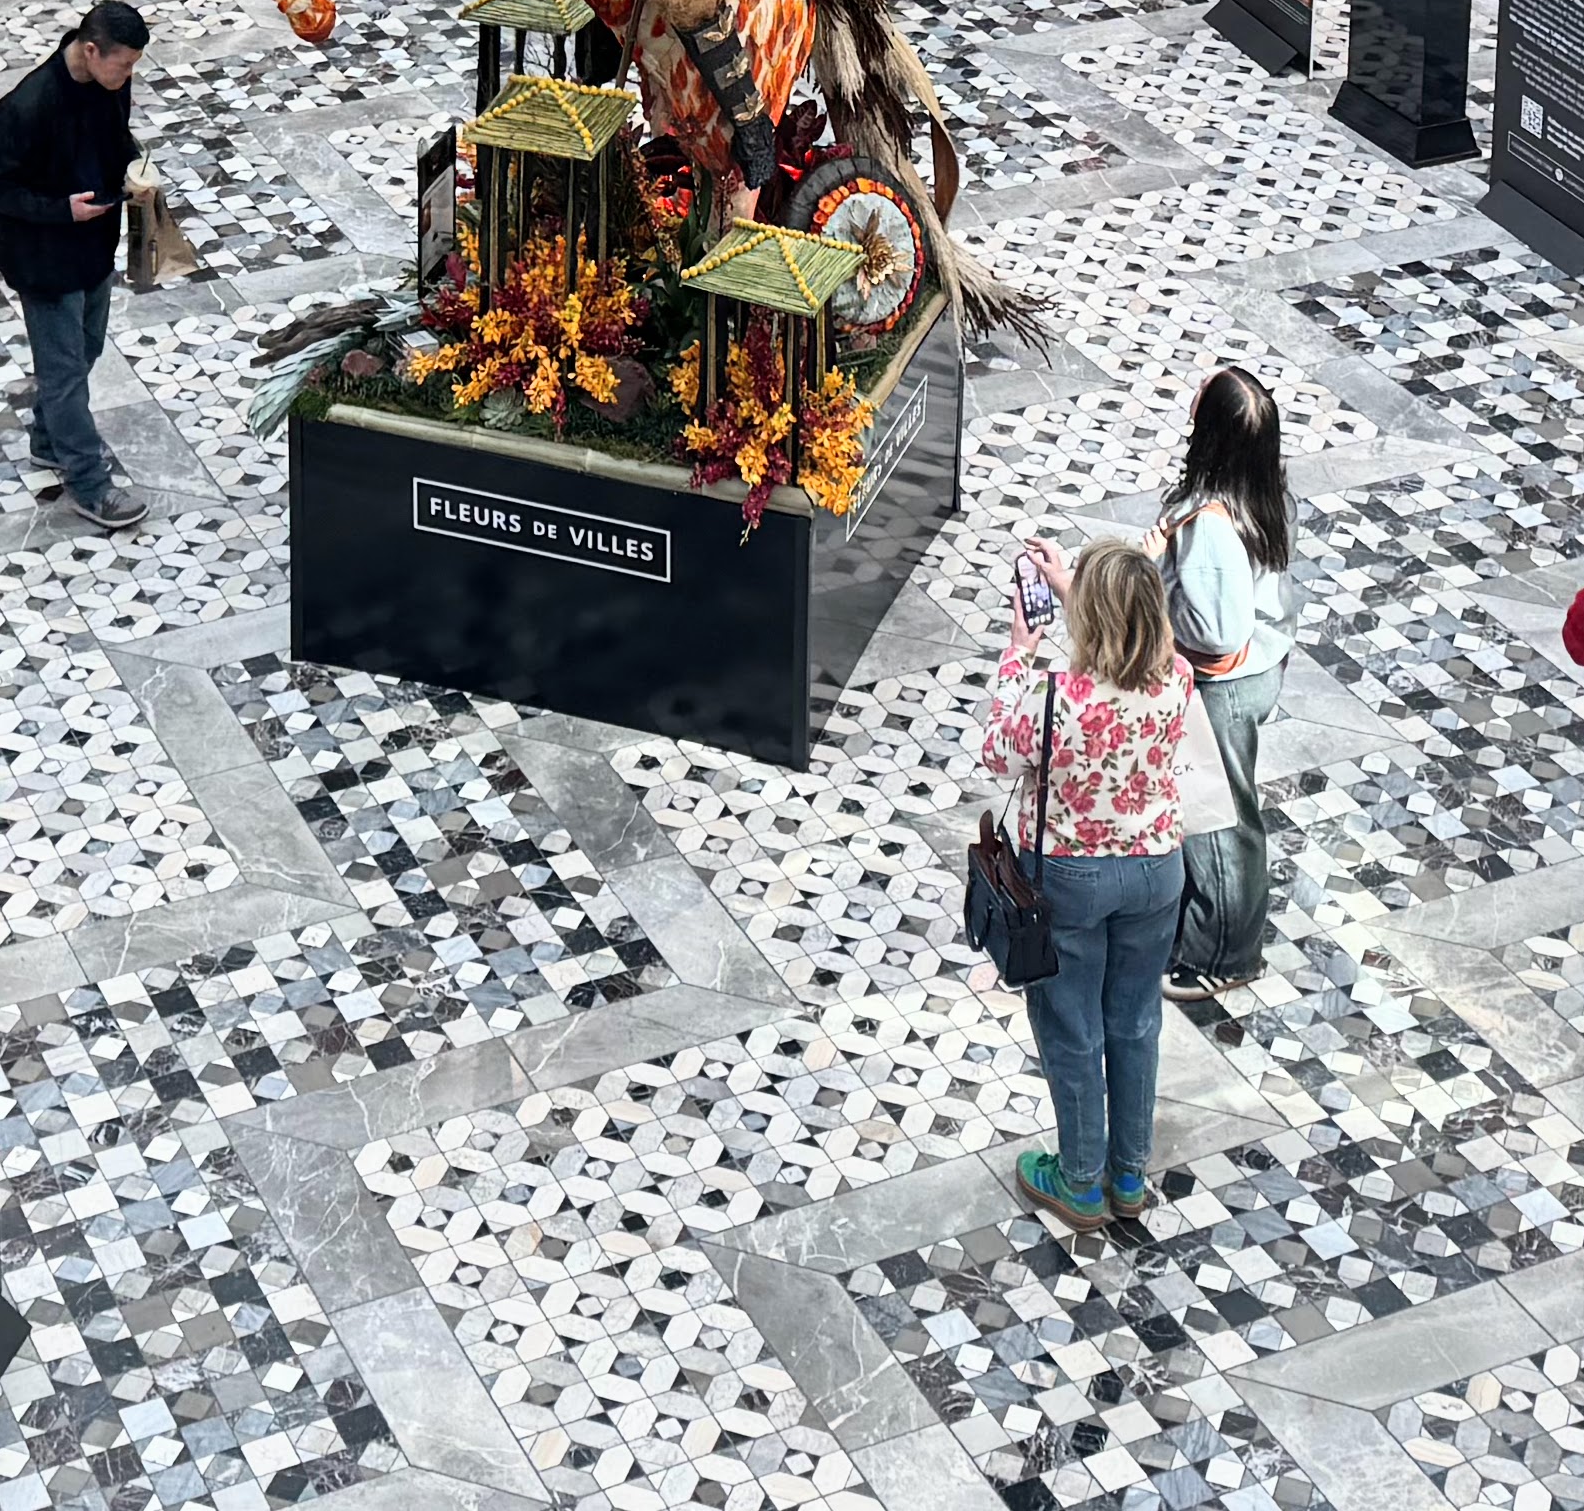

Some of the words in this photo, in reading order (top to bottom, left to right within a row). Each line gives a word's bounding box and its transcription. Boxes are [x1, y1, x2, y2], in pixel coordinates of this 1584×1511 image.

[430, 497, 522, 533] FLEURS
[532, 521, 557, 539] DE
[569, 526, 654, 561] VILLES
